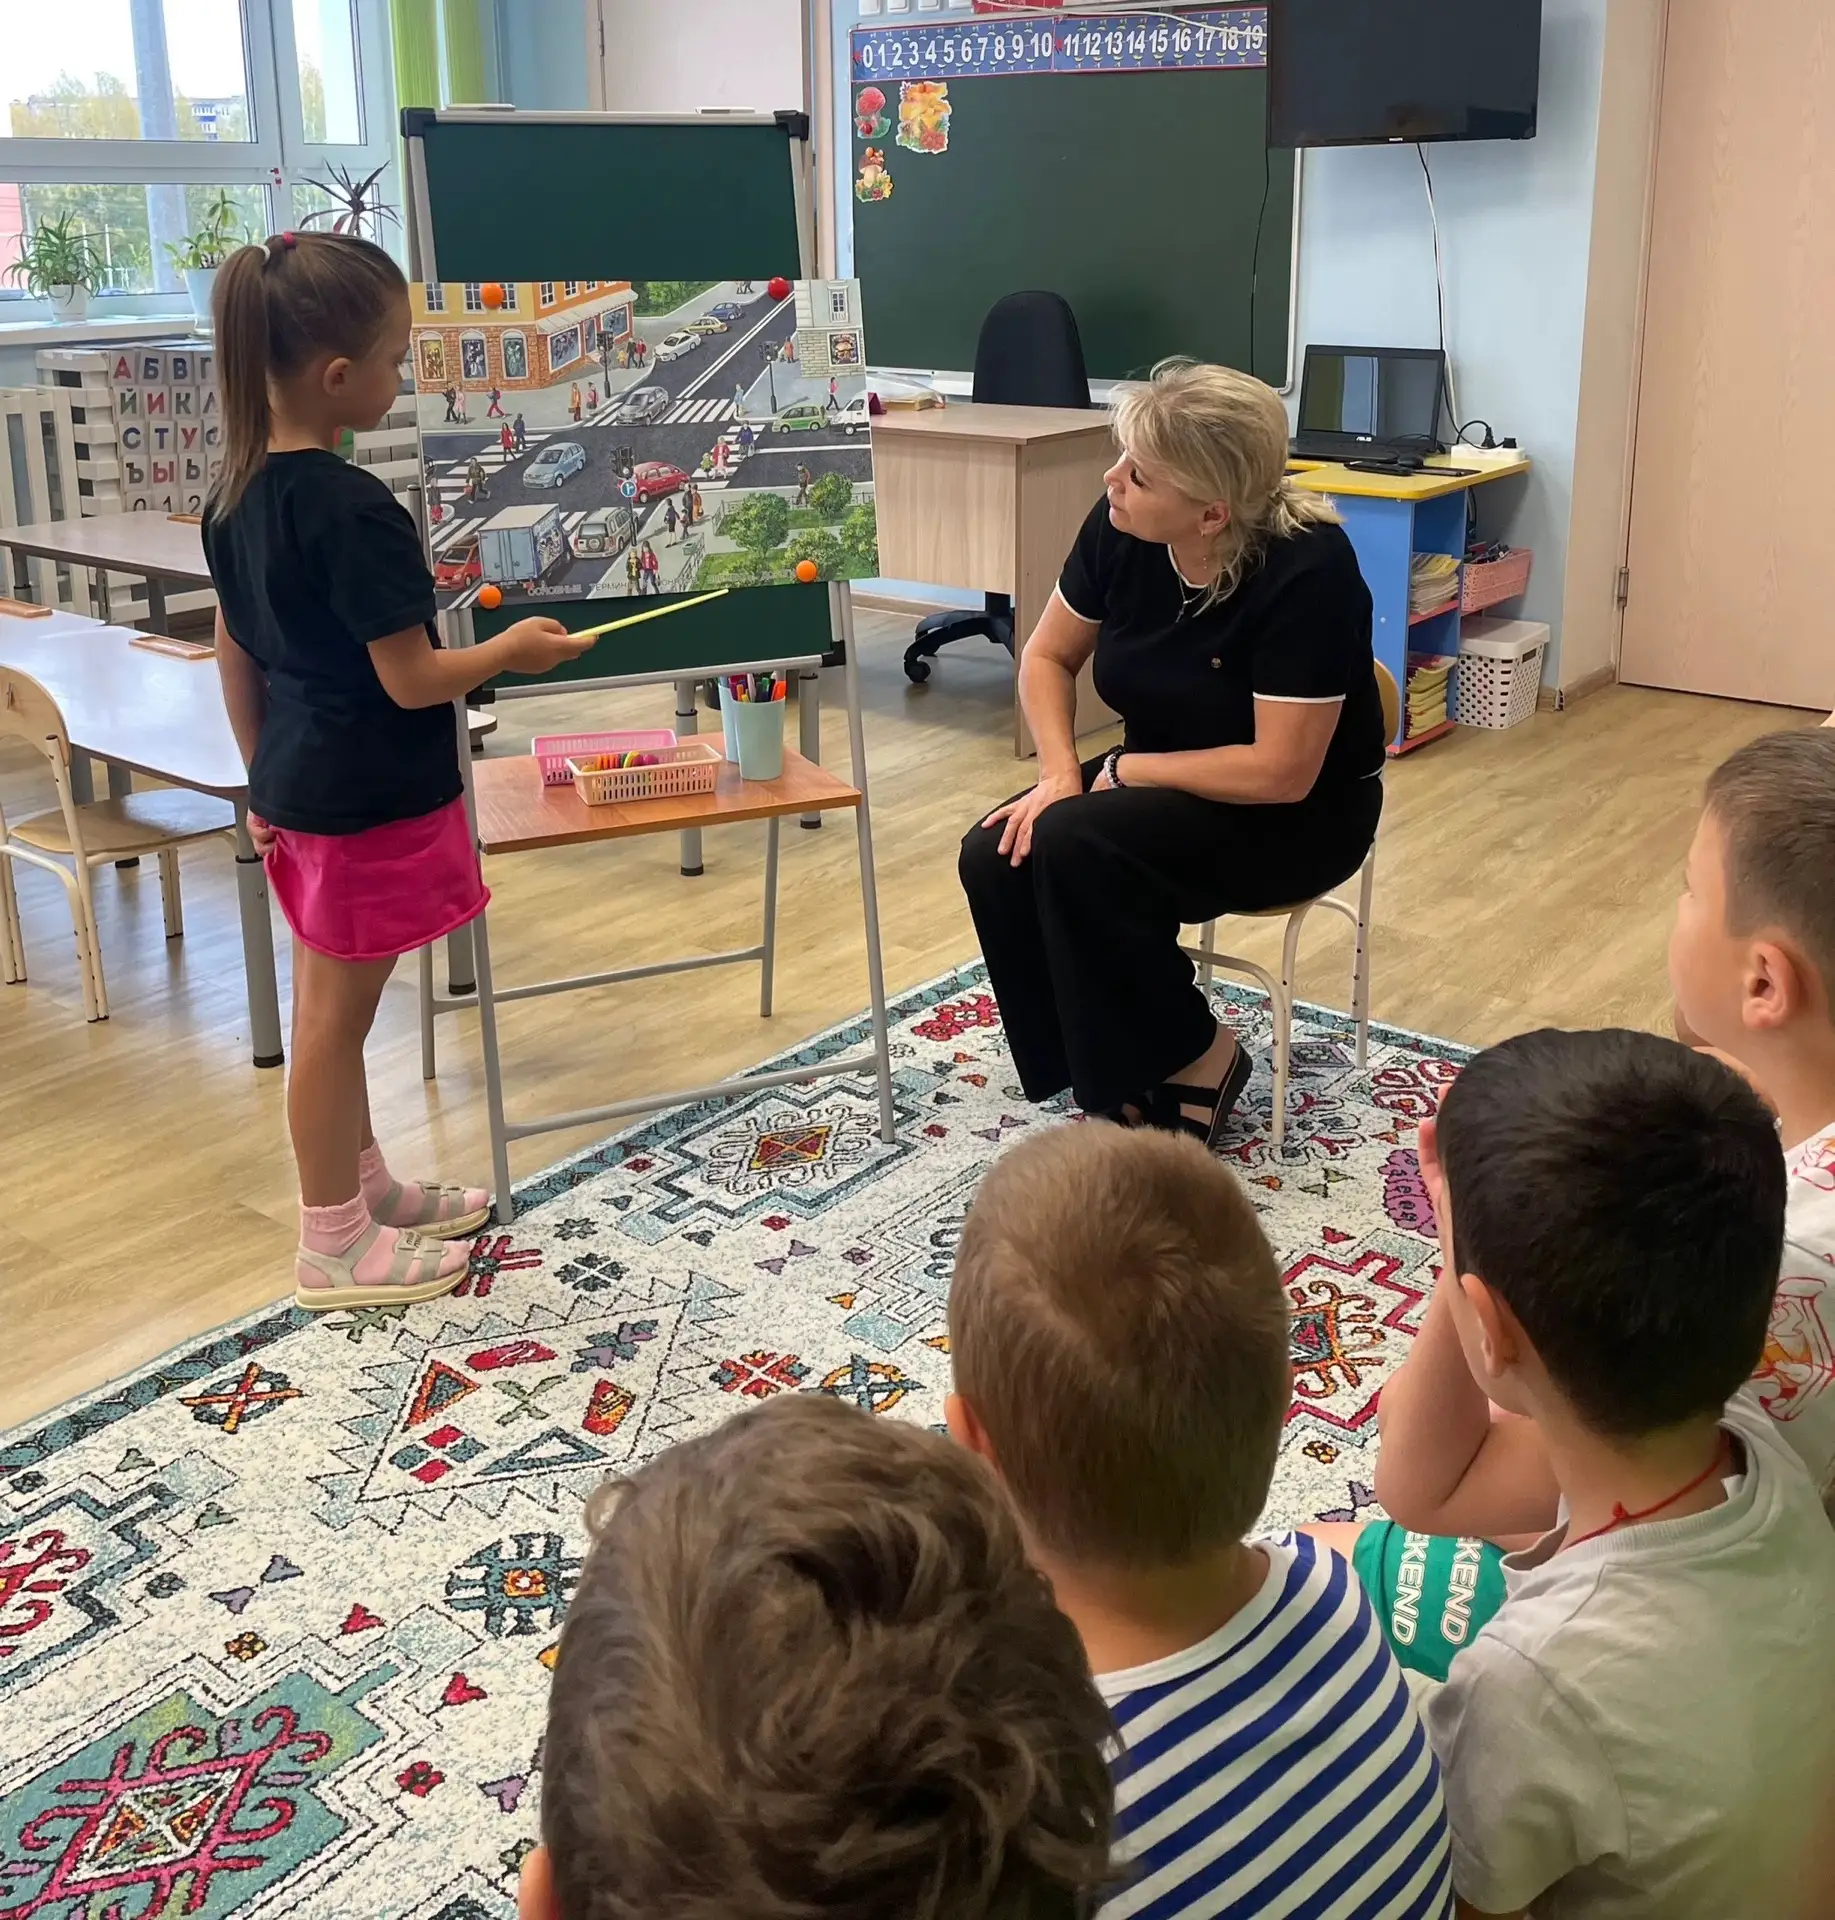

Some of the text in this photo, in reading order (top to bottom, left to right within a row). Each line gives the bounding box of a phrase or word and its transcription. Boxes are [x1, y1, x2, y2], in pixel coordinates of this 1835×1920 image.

[863, 32, 1052, 68] 0 1 2 3 4 5 6 7 8 9 10
[1064, 25, 1263, 56] 11 12 13 14 15 16 17 18 19
[113, 356, 211, 380] А Б В Г
[120, 388, 137, 415] Й
[147, 392, 164, 414] И
[175, 392, 191, 415] К
[122, 427, 140, 449] С
[155, 428, 168, 449] Т
[180, 428, 198, 449] У
[126, 462, 144, 484] Ъ
[153, 461, 174, 484] Ы
[186, 459, 200, 480] Ь
[1441, 1536, 1483, 1644] KEND
